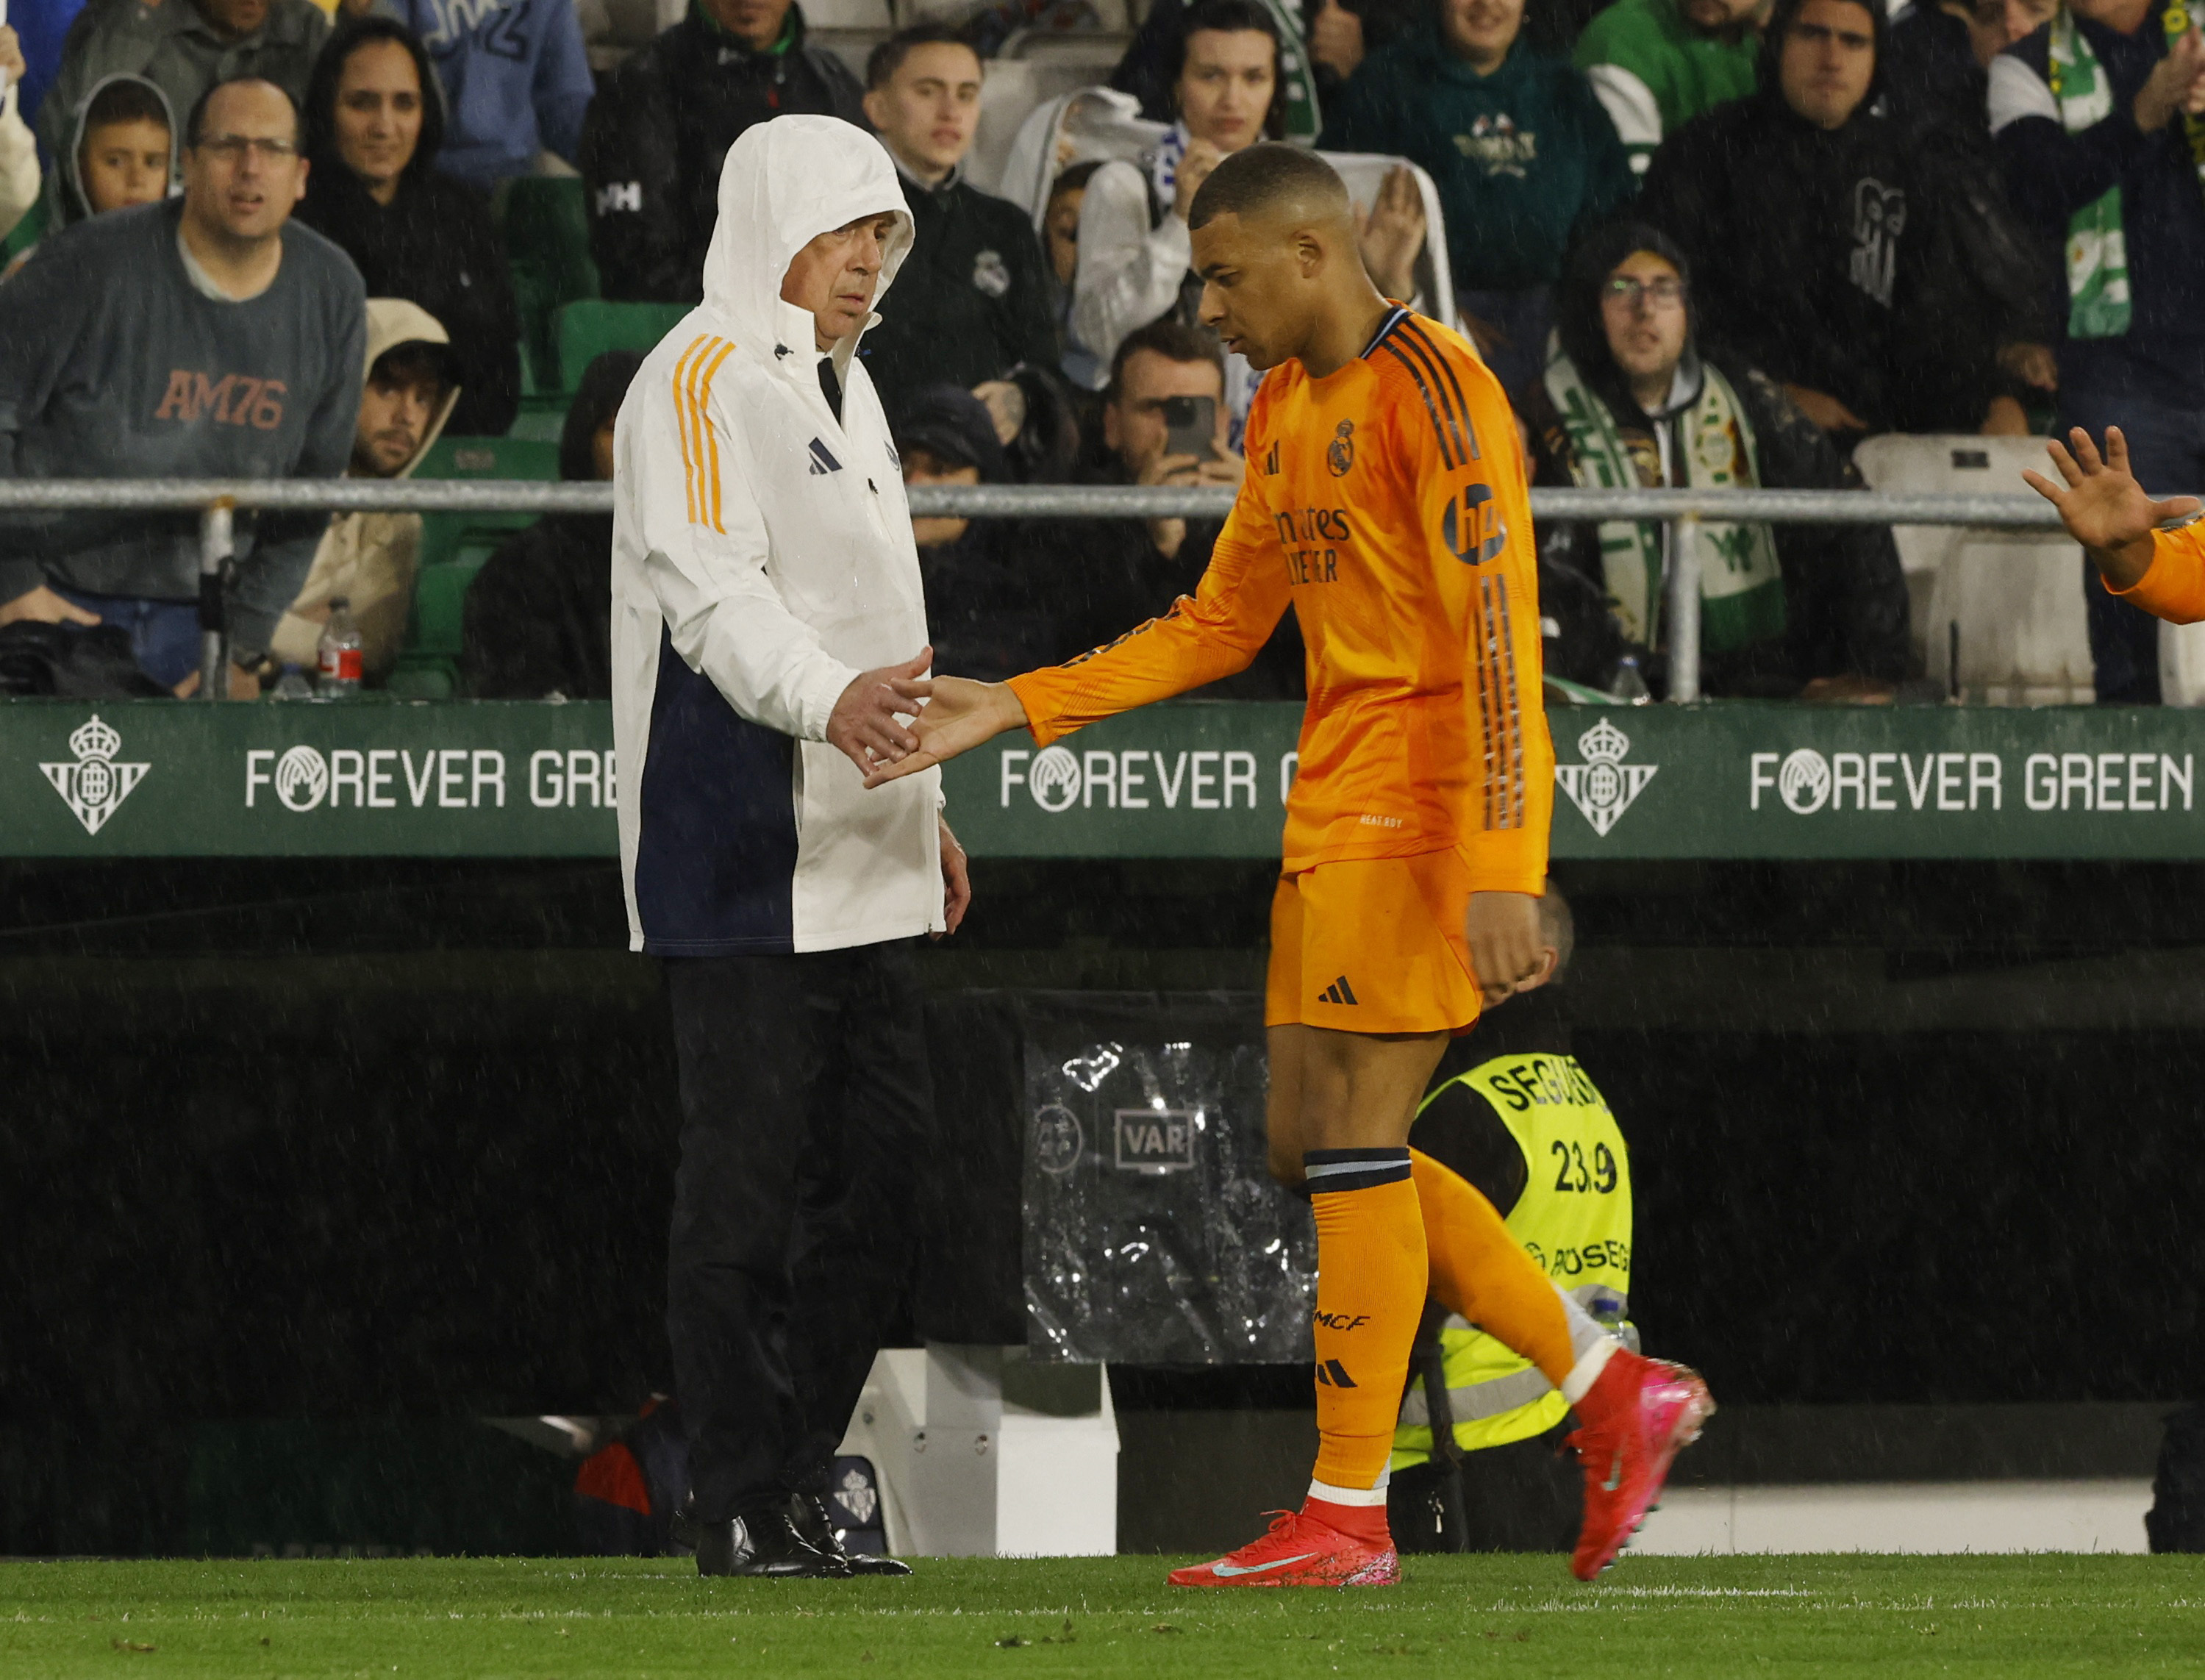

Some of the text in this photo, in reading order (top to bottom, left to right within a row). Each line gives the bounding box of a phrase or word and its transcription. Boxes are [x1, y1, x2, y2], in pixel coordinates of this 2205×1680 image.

[154, 370, 287, 430] AM76
[1445, 482, 1507, 566] hp
[246, 746, 506, 812] FOREVER
[1001, 746, 1257, 812] FOREVER
[1751, 748, 2194, 815] FOREVER GREEN
[1123, 1125, 1186, 1154] VAR
